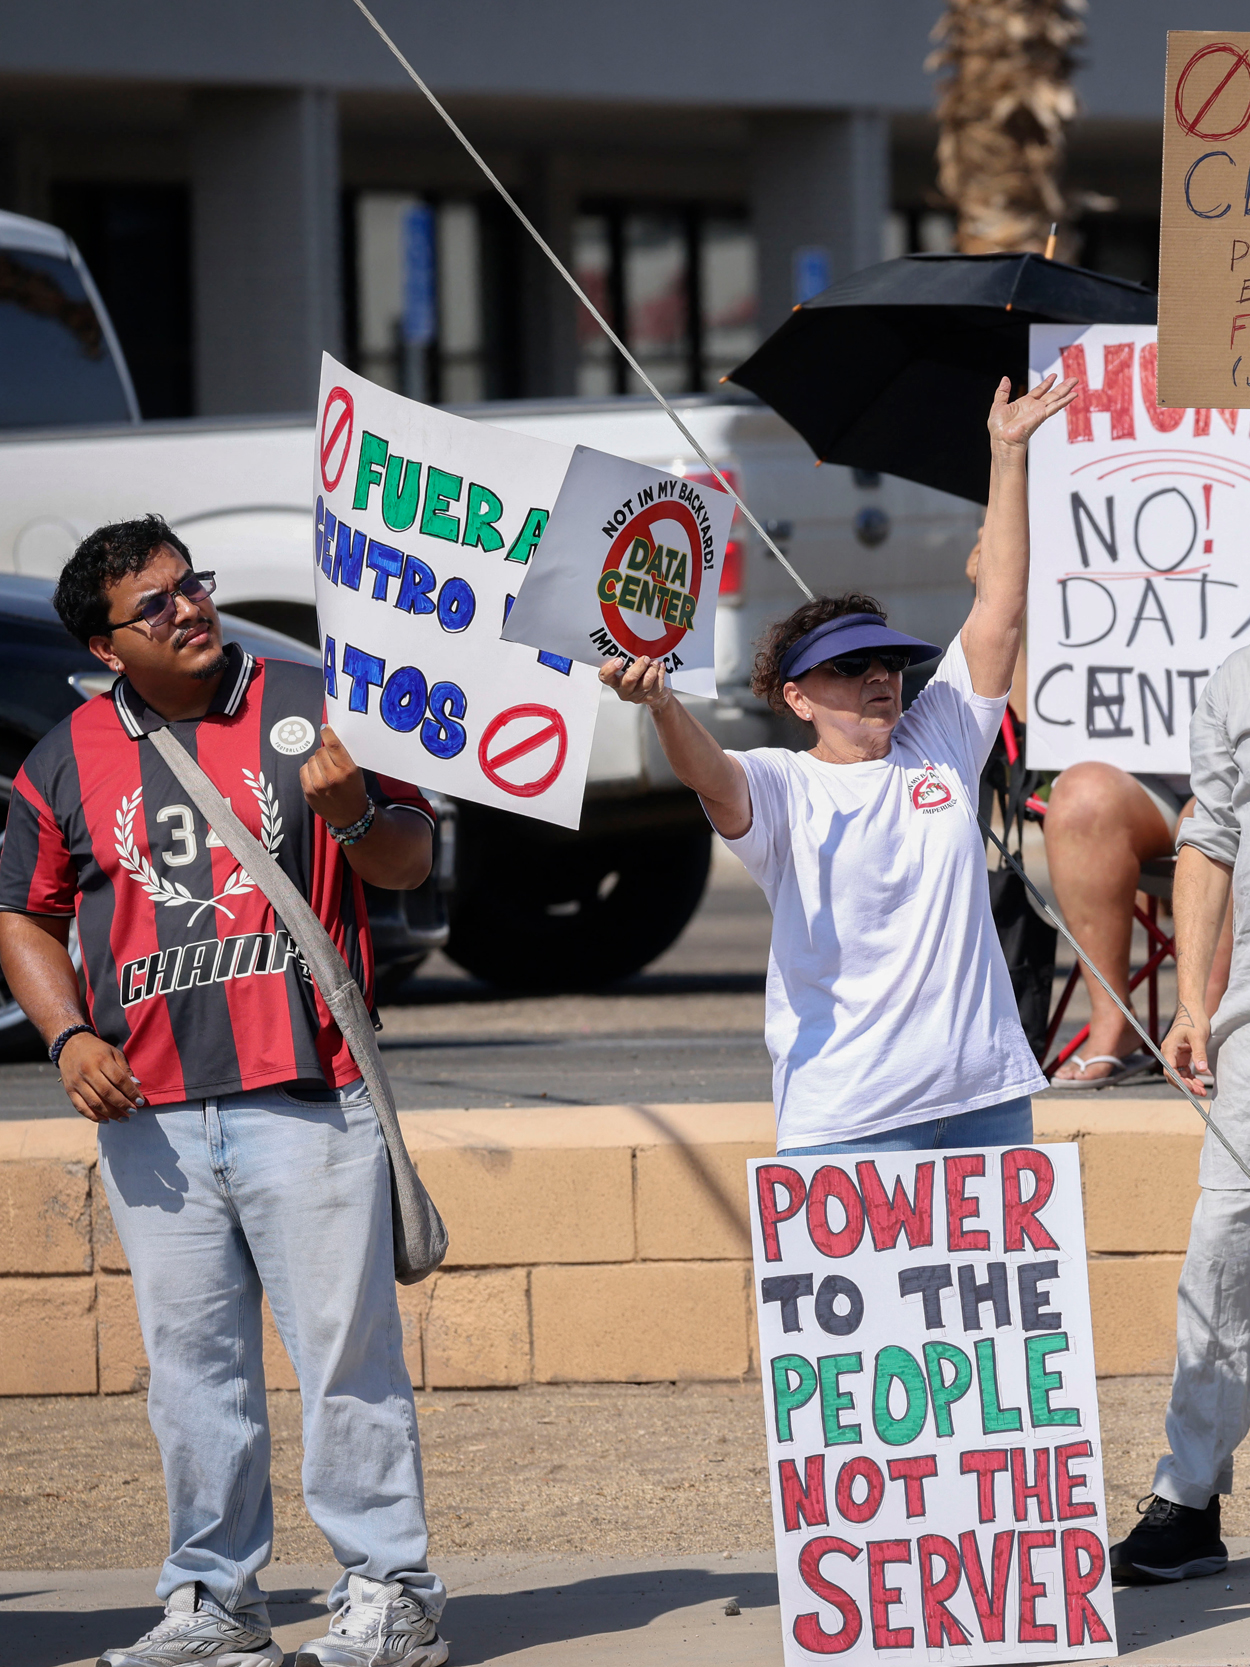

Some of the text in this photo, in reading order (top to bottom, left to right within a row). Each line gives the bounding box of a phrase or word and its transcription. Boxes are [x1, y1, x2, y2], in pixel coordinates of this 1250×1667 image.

[352, 430, 550, 565] FUERA
[601, 480, 715, 571] NOT IN MY BACKYARD!
[1070, 483, 1214, 572] NO!
[597, 568, 697, 631] CENTER
[626, 536, 688, 589] DATA
[318, 615, 467, 759] ATOS
[1034, 663, 1222, 746] CENT
[756, 1149, 1060, 1263] POWER
[761, 1260, 1063, 1336] TO THE
[770, 1332, 1081, 1447] PEOPLE
[778, 1440, 1098, 1532] NOT THE
[793, 1528, 1112, 1655] SERVER
